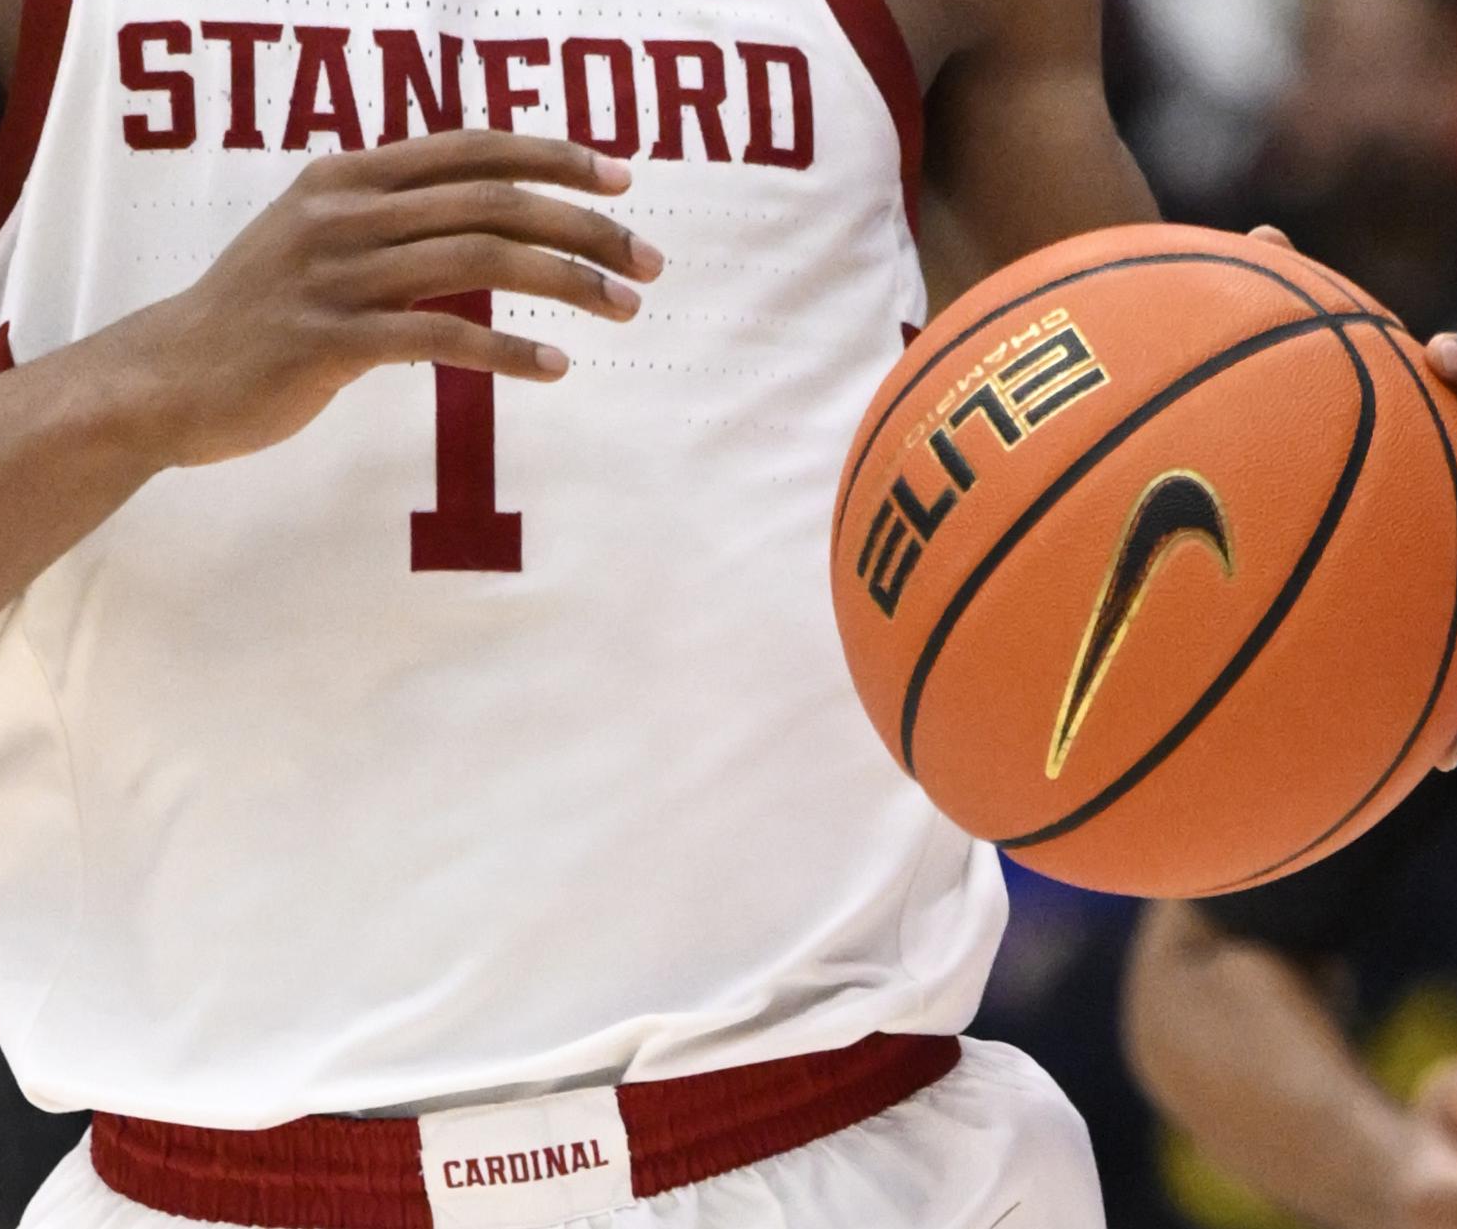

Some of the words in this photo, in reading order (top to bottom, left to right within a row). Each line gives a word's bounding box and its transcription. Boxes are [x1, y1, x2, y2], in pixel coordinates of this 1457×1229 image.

[117, 19, 815, 171] STANFORD
[409, 288, 523, 573] 1
[856, 322, 1111, 619] ELITE
[442, 1138, 610, 1189] CARDINAL
